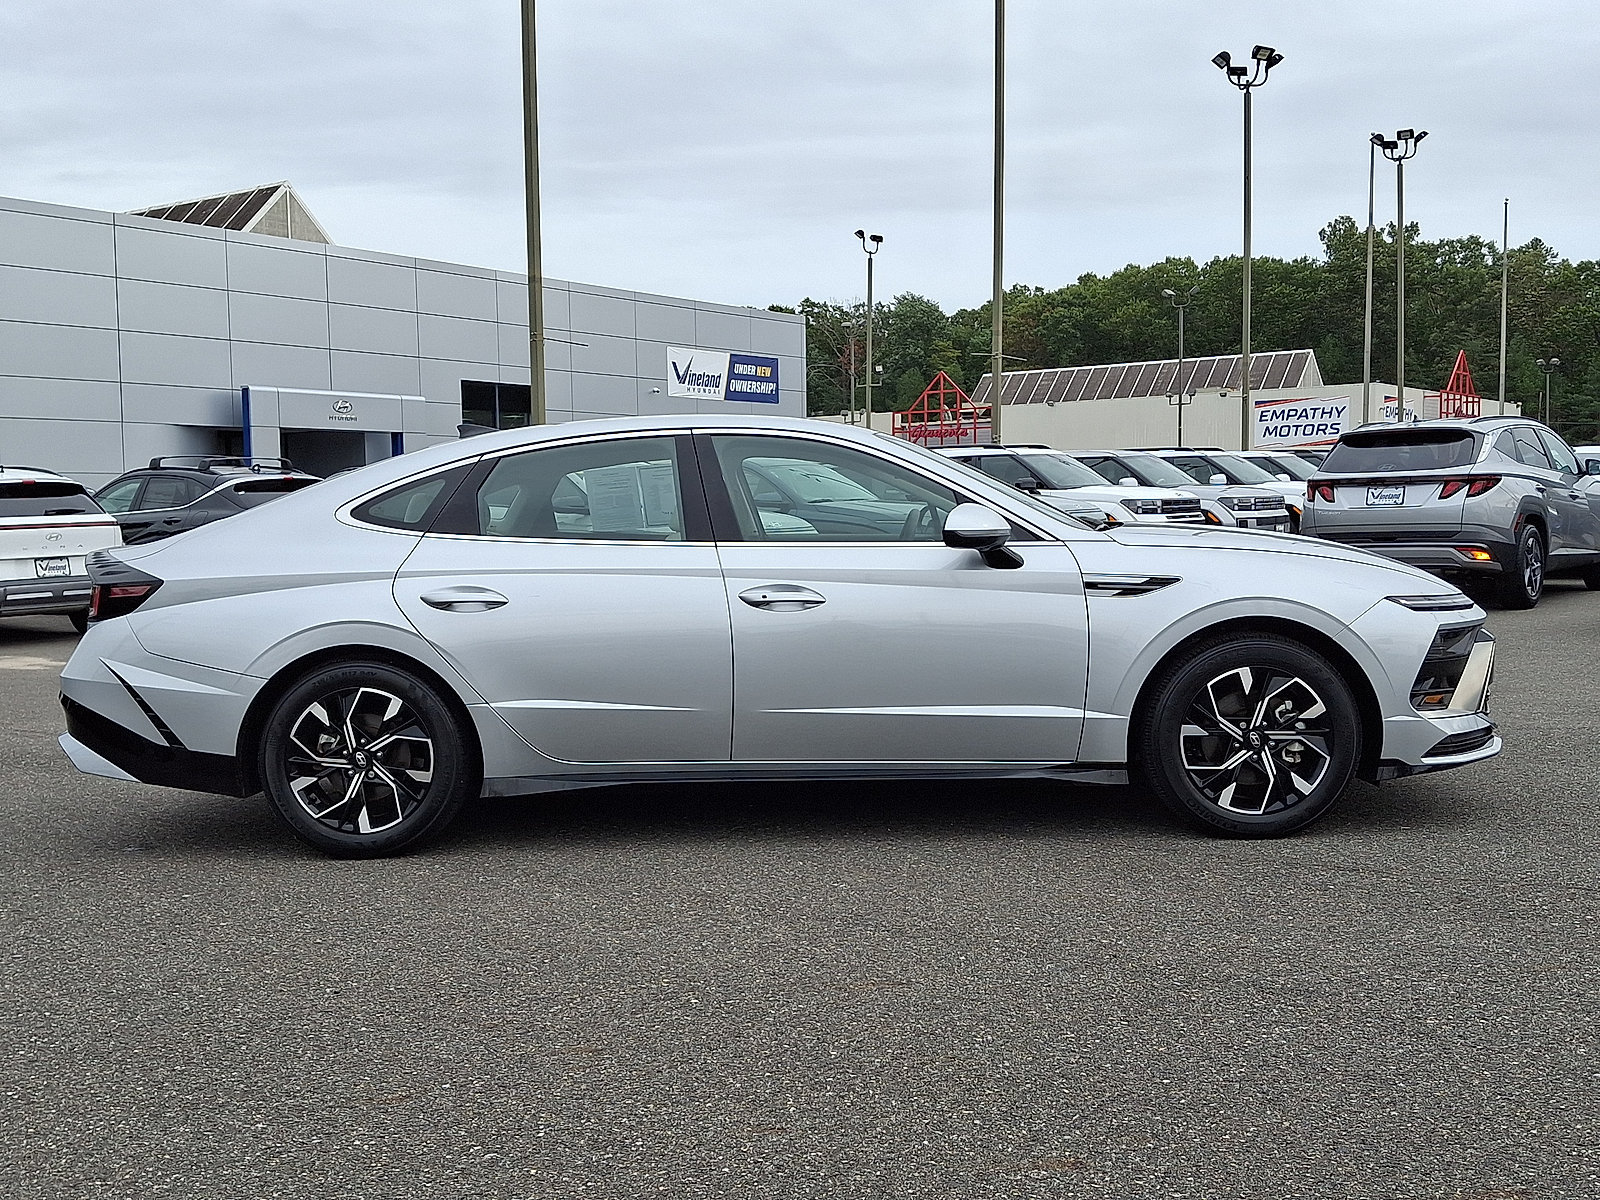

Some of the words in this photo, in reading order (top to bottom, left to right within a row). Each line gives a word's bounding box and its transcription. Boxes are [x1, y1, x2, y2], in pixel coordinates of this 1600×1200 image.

[671, 355, 722, 389] Vineland
[734, 363, 756, 375] UNDER
[756, 366, 772, 377] NEW
[686, 386, 721, 395] HYUNDAI
[730, 379, 776, 394] OWNERSHIP!
[1258, 405, 1347, 423] EMPATHY
[1262, 422, 1342, 438] MOTORS
